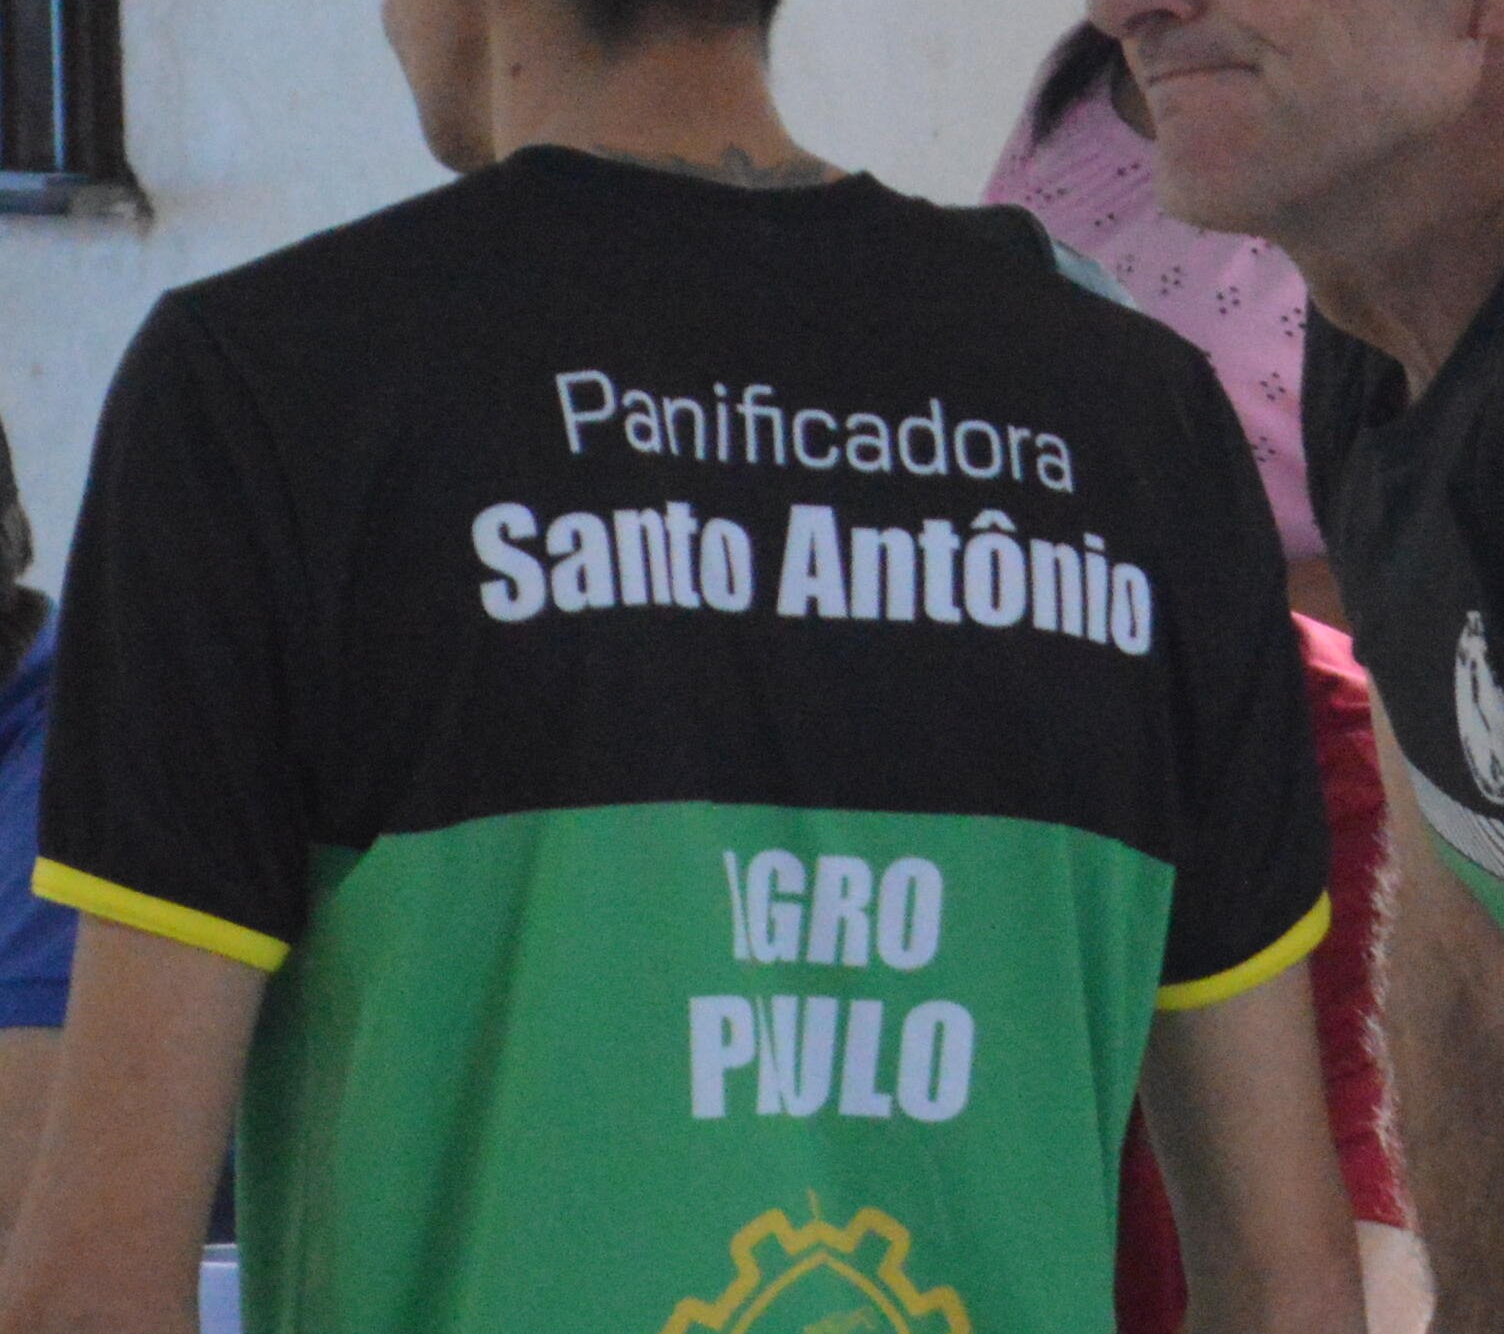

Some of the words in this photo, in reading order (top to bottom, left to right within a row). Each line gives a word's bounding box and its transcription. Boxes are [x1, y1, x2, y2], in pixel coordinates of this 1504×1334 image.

[556, 370, 1075, 493] Panificadora
[472, 500, 754, 622] Santo
[776, 504, 1153, 656] Antônio
